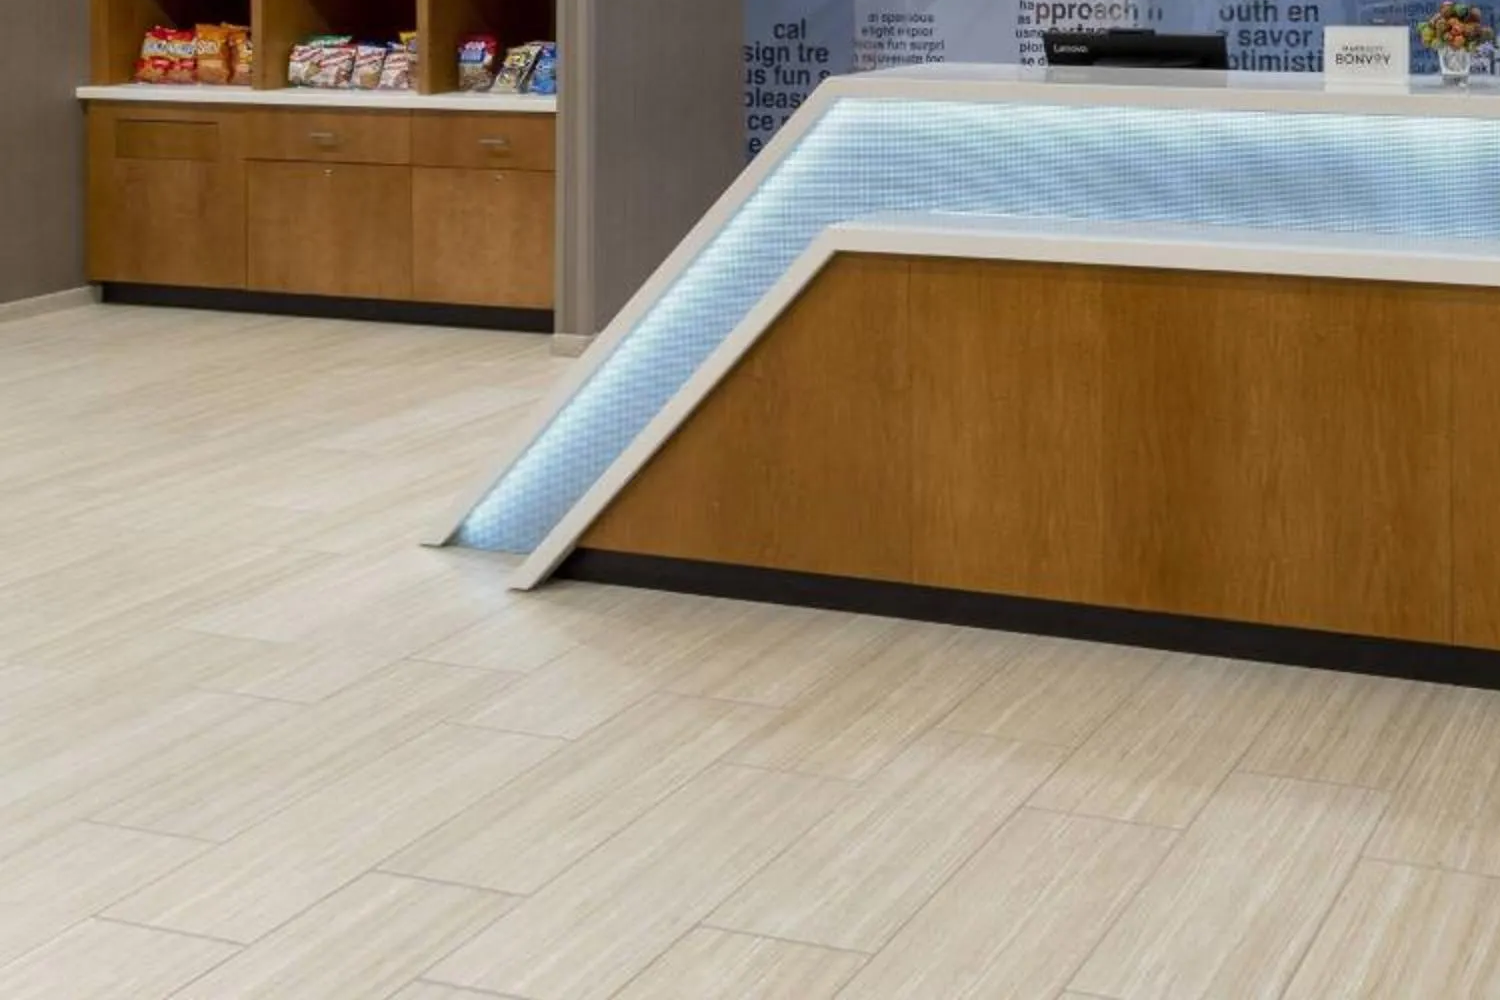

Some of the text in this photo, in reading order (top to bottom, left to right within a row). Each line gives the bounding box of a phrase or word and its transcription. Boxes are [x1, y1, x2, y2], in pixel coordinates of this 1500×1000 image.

[1035, 0, 1139, 25] pproach
[1287, 3, 1320, 23] en
[773, 18, 806, 39] cal
[1238, 28, 1313, 48] savor
[743, 40, 830, 68] sign tre
[1335, 53, 1391, 65] BONVOY
[774, 65, 811, 86] fun
[744, 87, 810, 109] leas
[747, 113, 774, 131] ce
